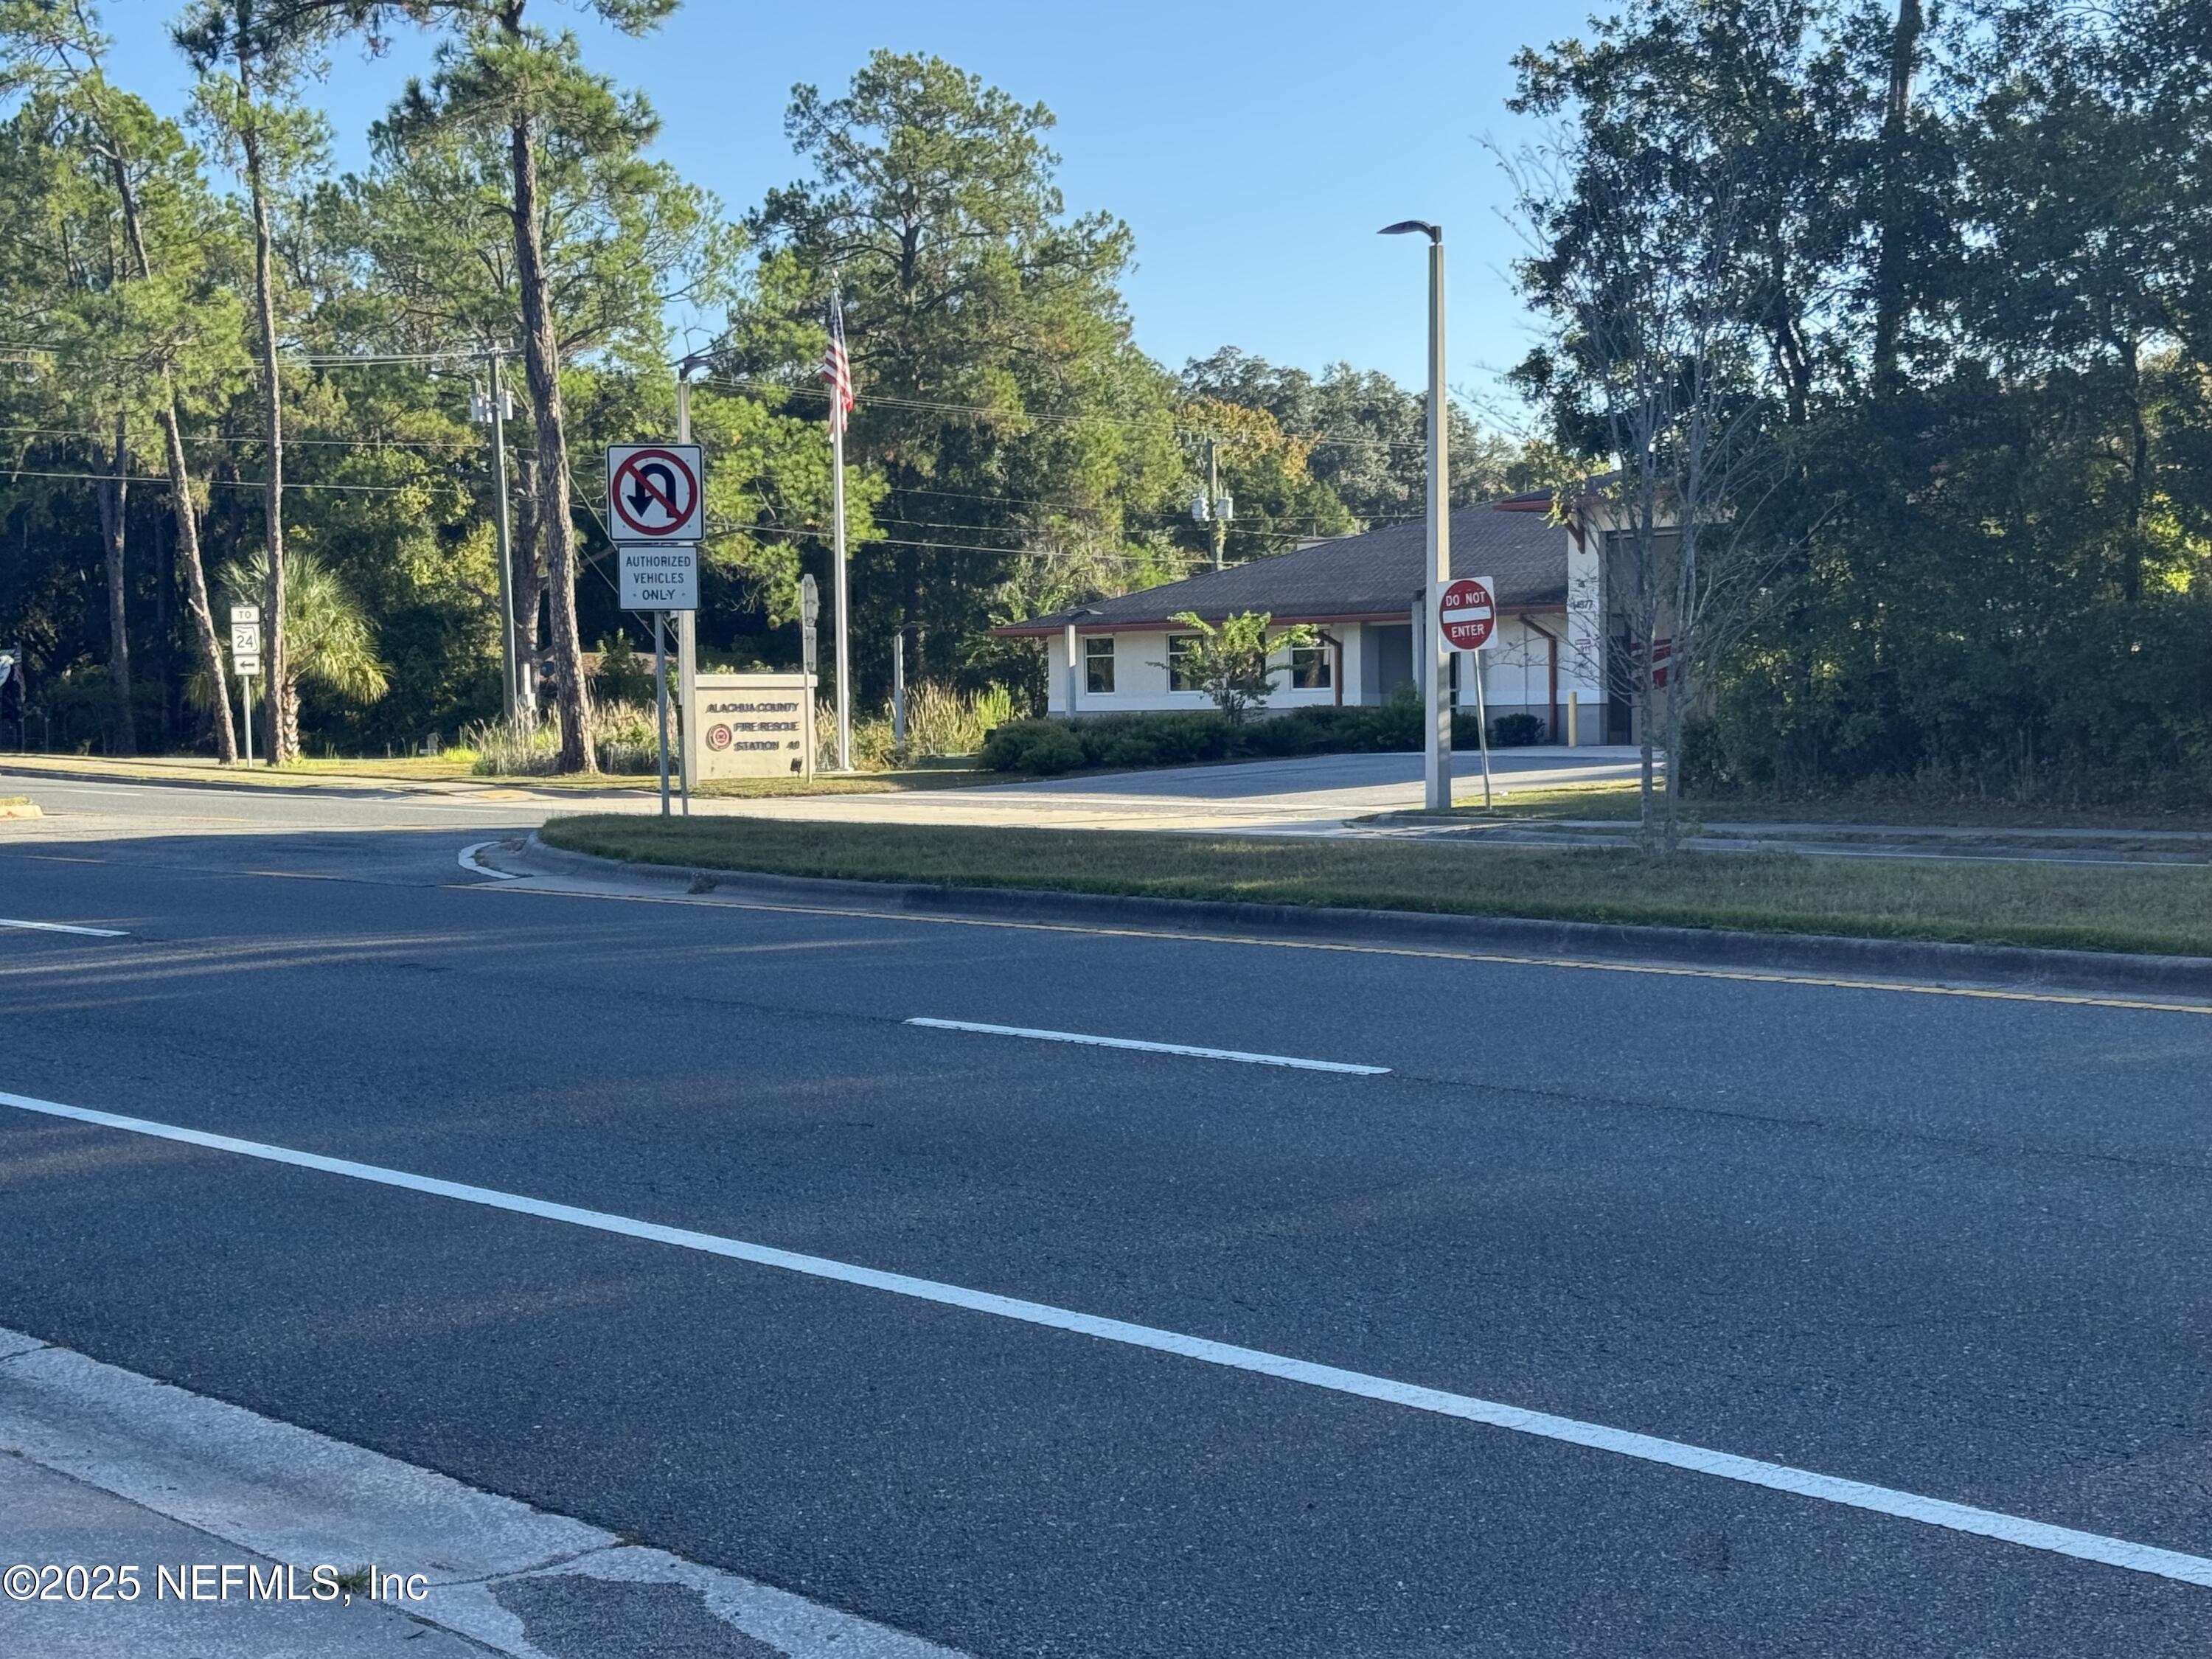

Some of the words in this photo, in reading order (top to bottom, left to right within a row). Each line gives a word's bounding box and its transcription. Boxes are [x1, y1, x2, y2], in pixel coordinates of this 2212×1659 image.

[626, 556, 691, 567] AUTHORIZED
[633, 573, 684, 584] VEHICLES
[642, 589, 675, 601] ONLY
[1446, 594, 1460, 607] DO
[1466, 591, 1486, 605] NOT
[238, 611, 251, 619] TO
[1451, 624, 1485, 638] ENTER
[237, 635, 253, 649] 24
[706, 703, 755, 713] ALACHUA
[756, 702, 799, 713] COUNTY
[734, 722, 757, 731] FIRE
[759, 721, 800, 731] RESCUE
[734, 741, 779, 751] STATION
